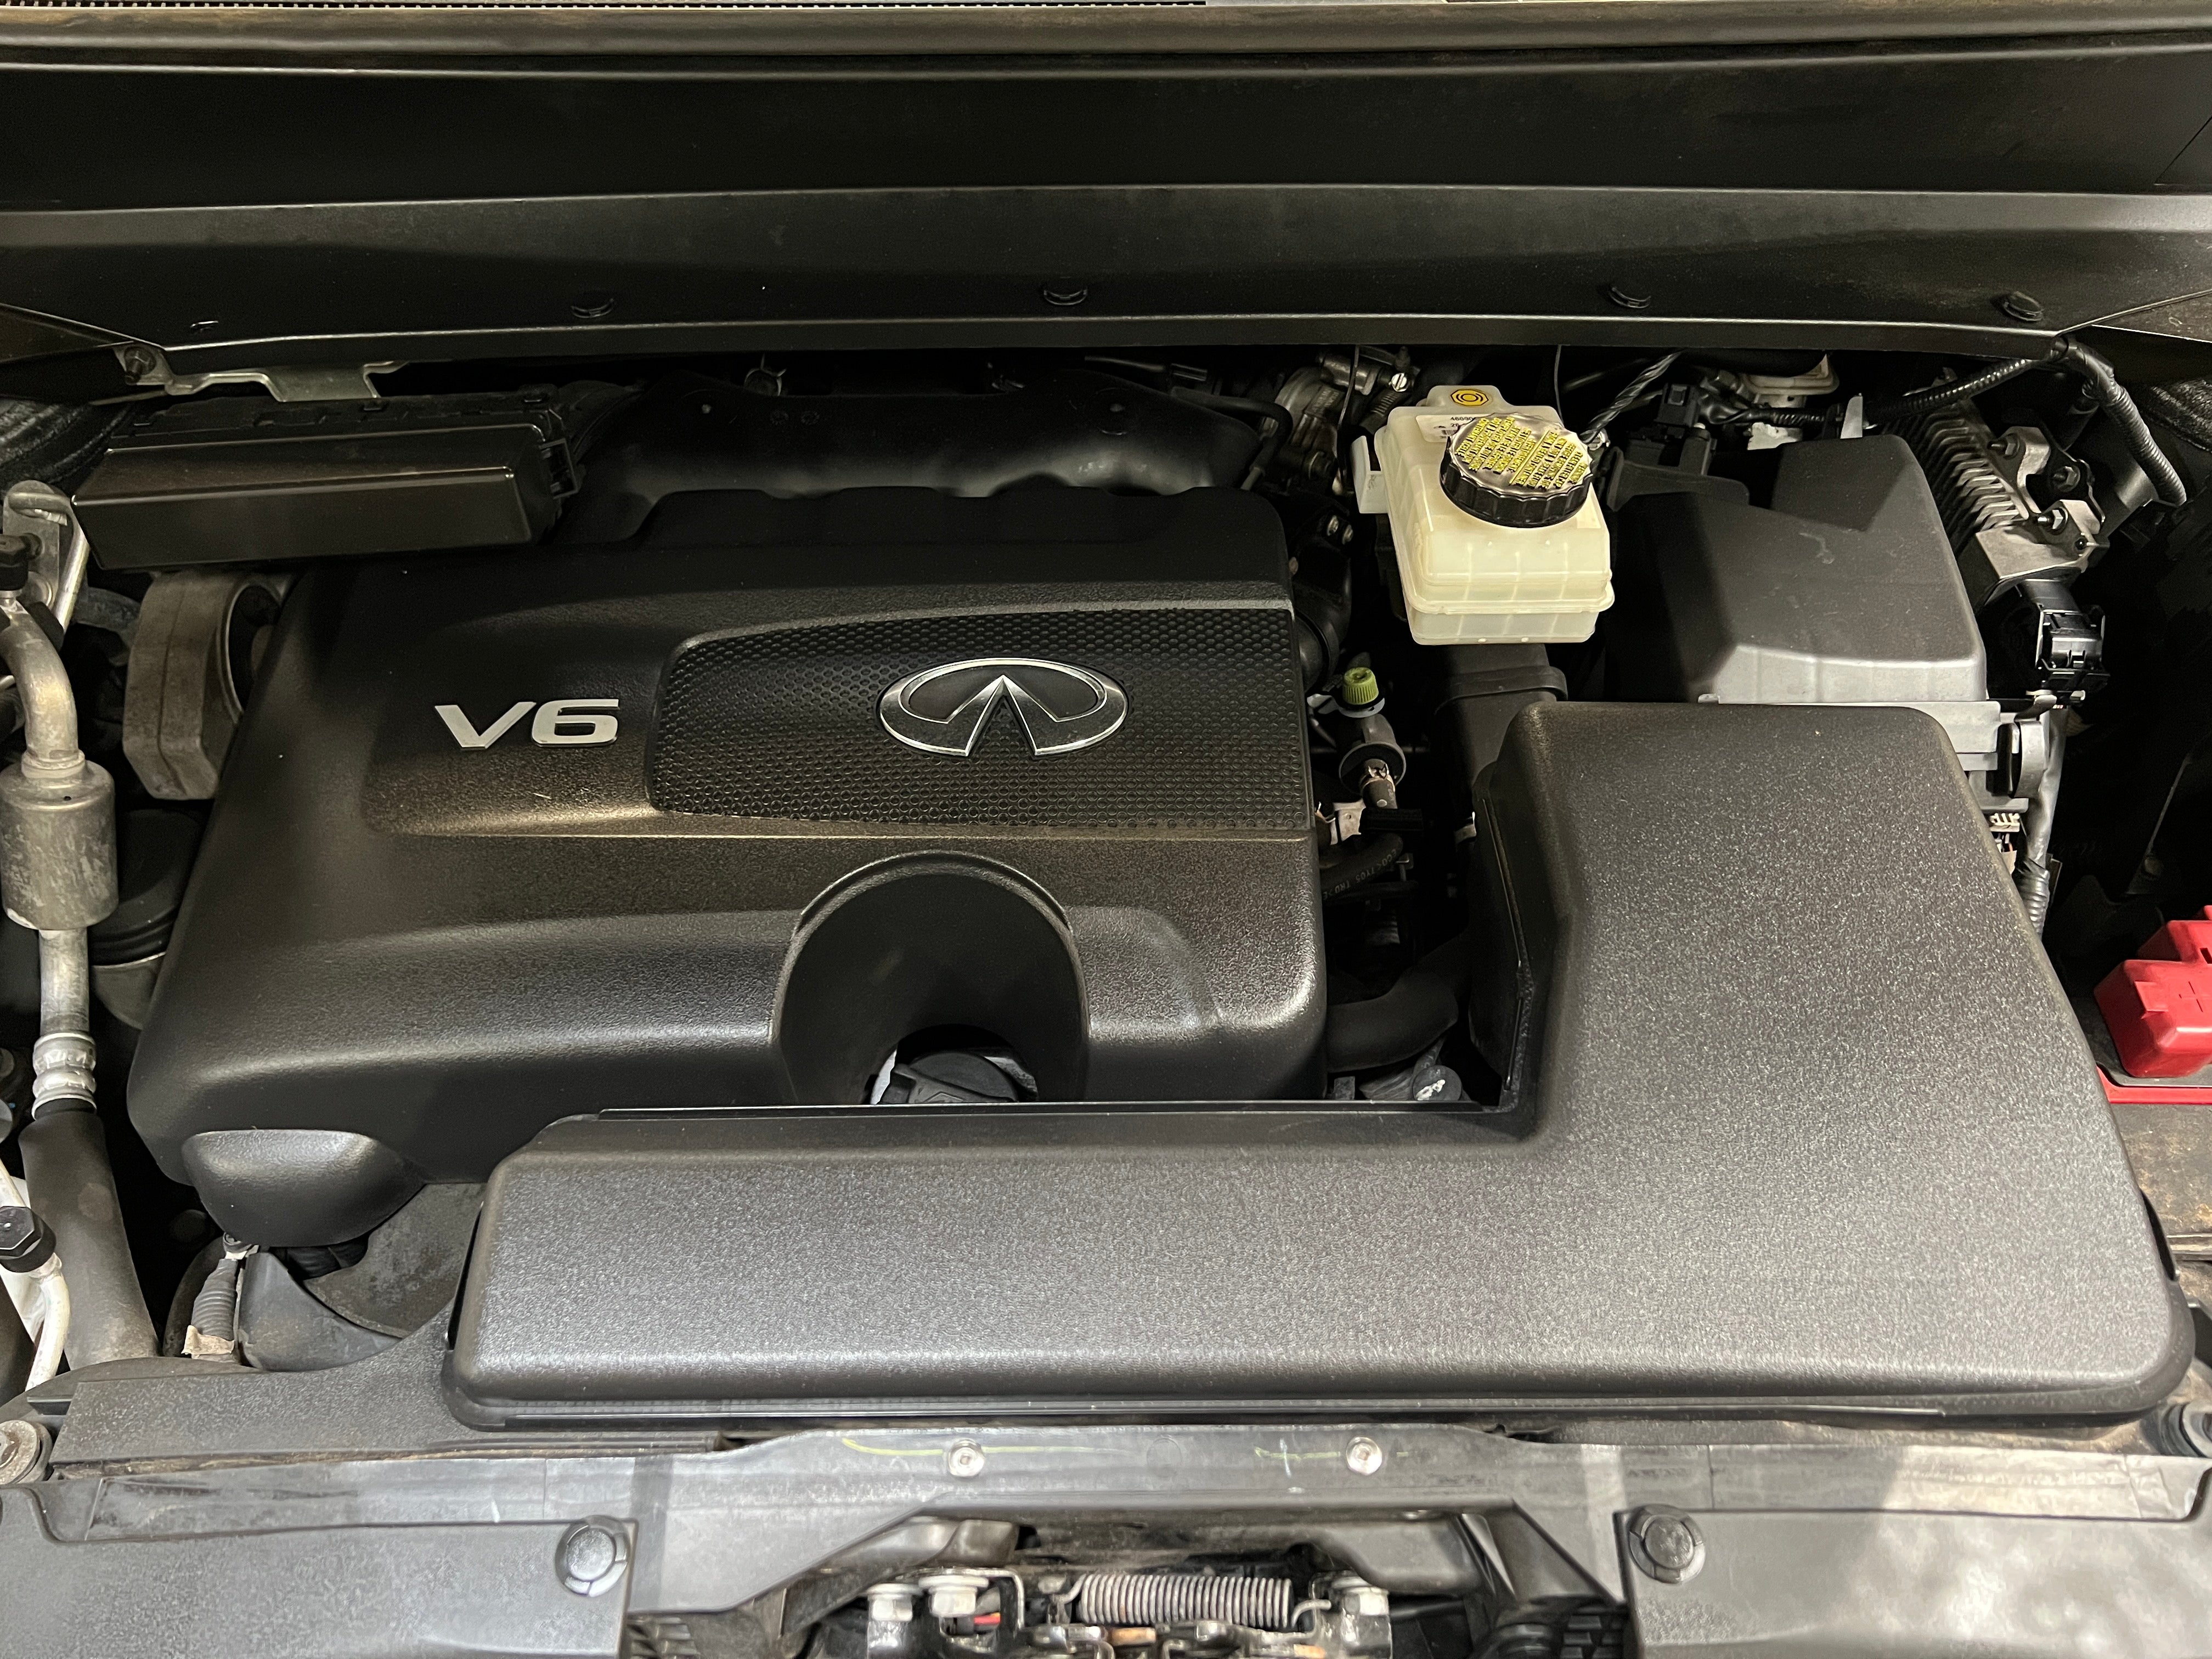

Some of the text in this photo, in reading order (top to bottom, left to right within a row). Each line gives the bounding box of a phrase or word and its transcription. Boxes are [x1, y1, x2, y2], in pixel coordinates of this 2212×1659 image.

[1489, 416, 1502, 426] DOT
[1466, 417, 1490, 441] CONTENANT
[1505, 425, 1522, 440] AVANT
[1470, 429, 1493, 453] PROVENANT
[1511, 428, 1532, 449] NETTOYER
[1544, 431, 1559, 444] FROM
[1554, 437, 1567, 448] ONLY
[1531, 447, 1548, 462] SEALED
[1548, 447, 1560, 457] DOT
[1560, 442, 1577, 458] BEFORE
[1469, 454, 1487, 471] LIQUIDE
[1493, 453, 1514, 473] BOUCHON
[1536, 460, 1551, 475] BRAKE
[1553, 451, 1583, 487] CLEAN FILLER CAP
[1515, 461, 1538, 485] CONTAINER
[1527, 473, 1542, 487] FLUID
[1538, 478, 1551, 489] USE
[435, 698, 620, 748] V6
